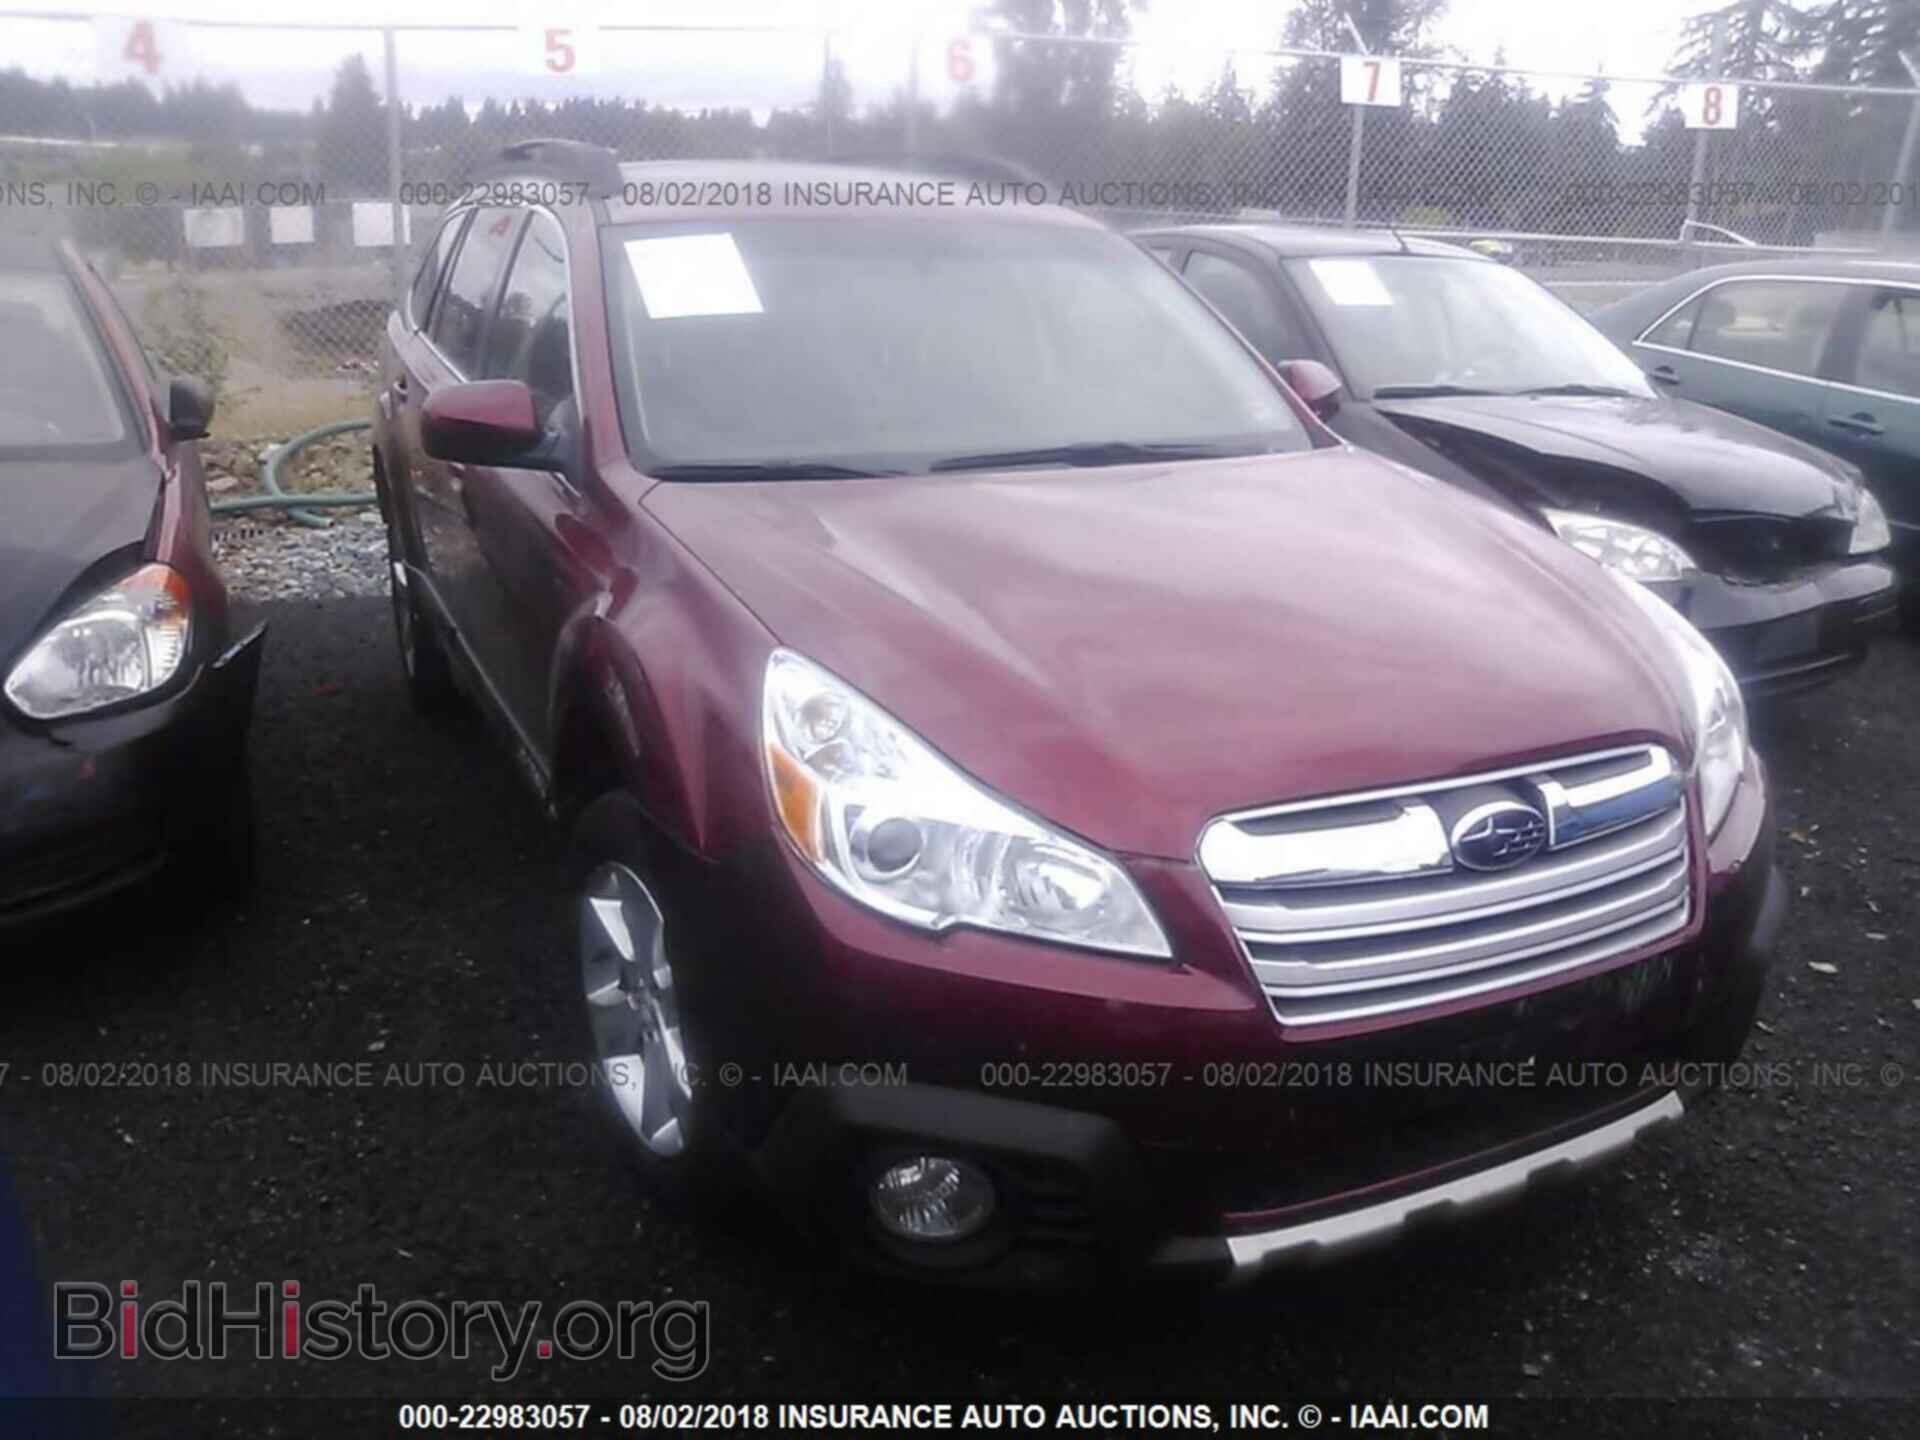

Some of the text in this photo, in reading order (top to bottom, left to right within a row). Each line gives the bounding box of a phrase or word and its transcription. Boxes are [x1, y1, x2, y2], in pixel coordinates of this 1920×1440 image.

[123, 21, 162, 74] 4
[544, 28, 575, 73] 5
[947, 37, 974, 83] 6
[1361, 61, 1381, 102] 7
[1702, 87, 1722, 125] 8
